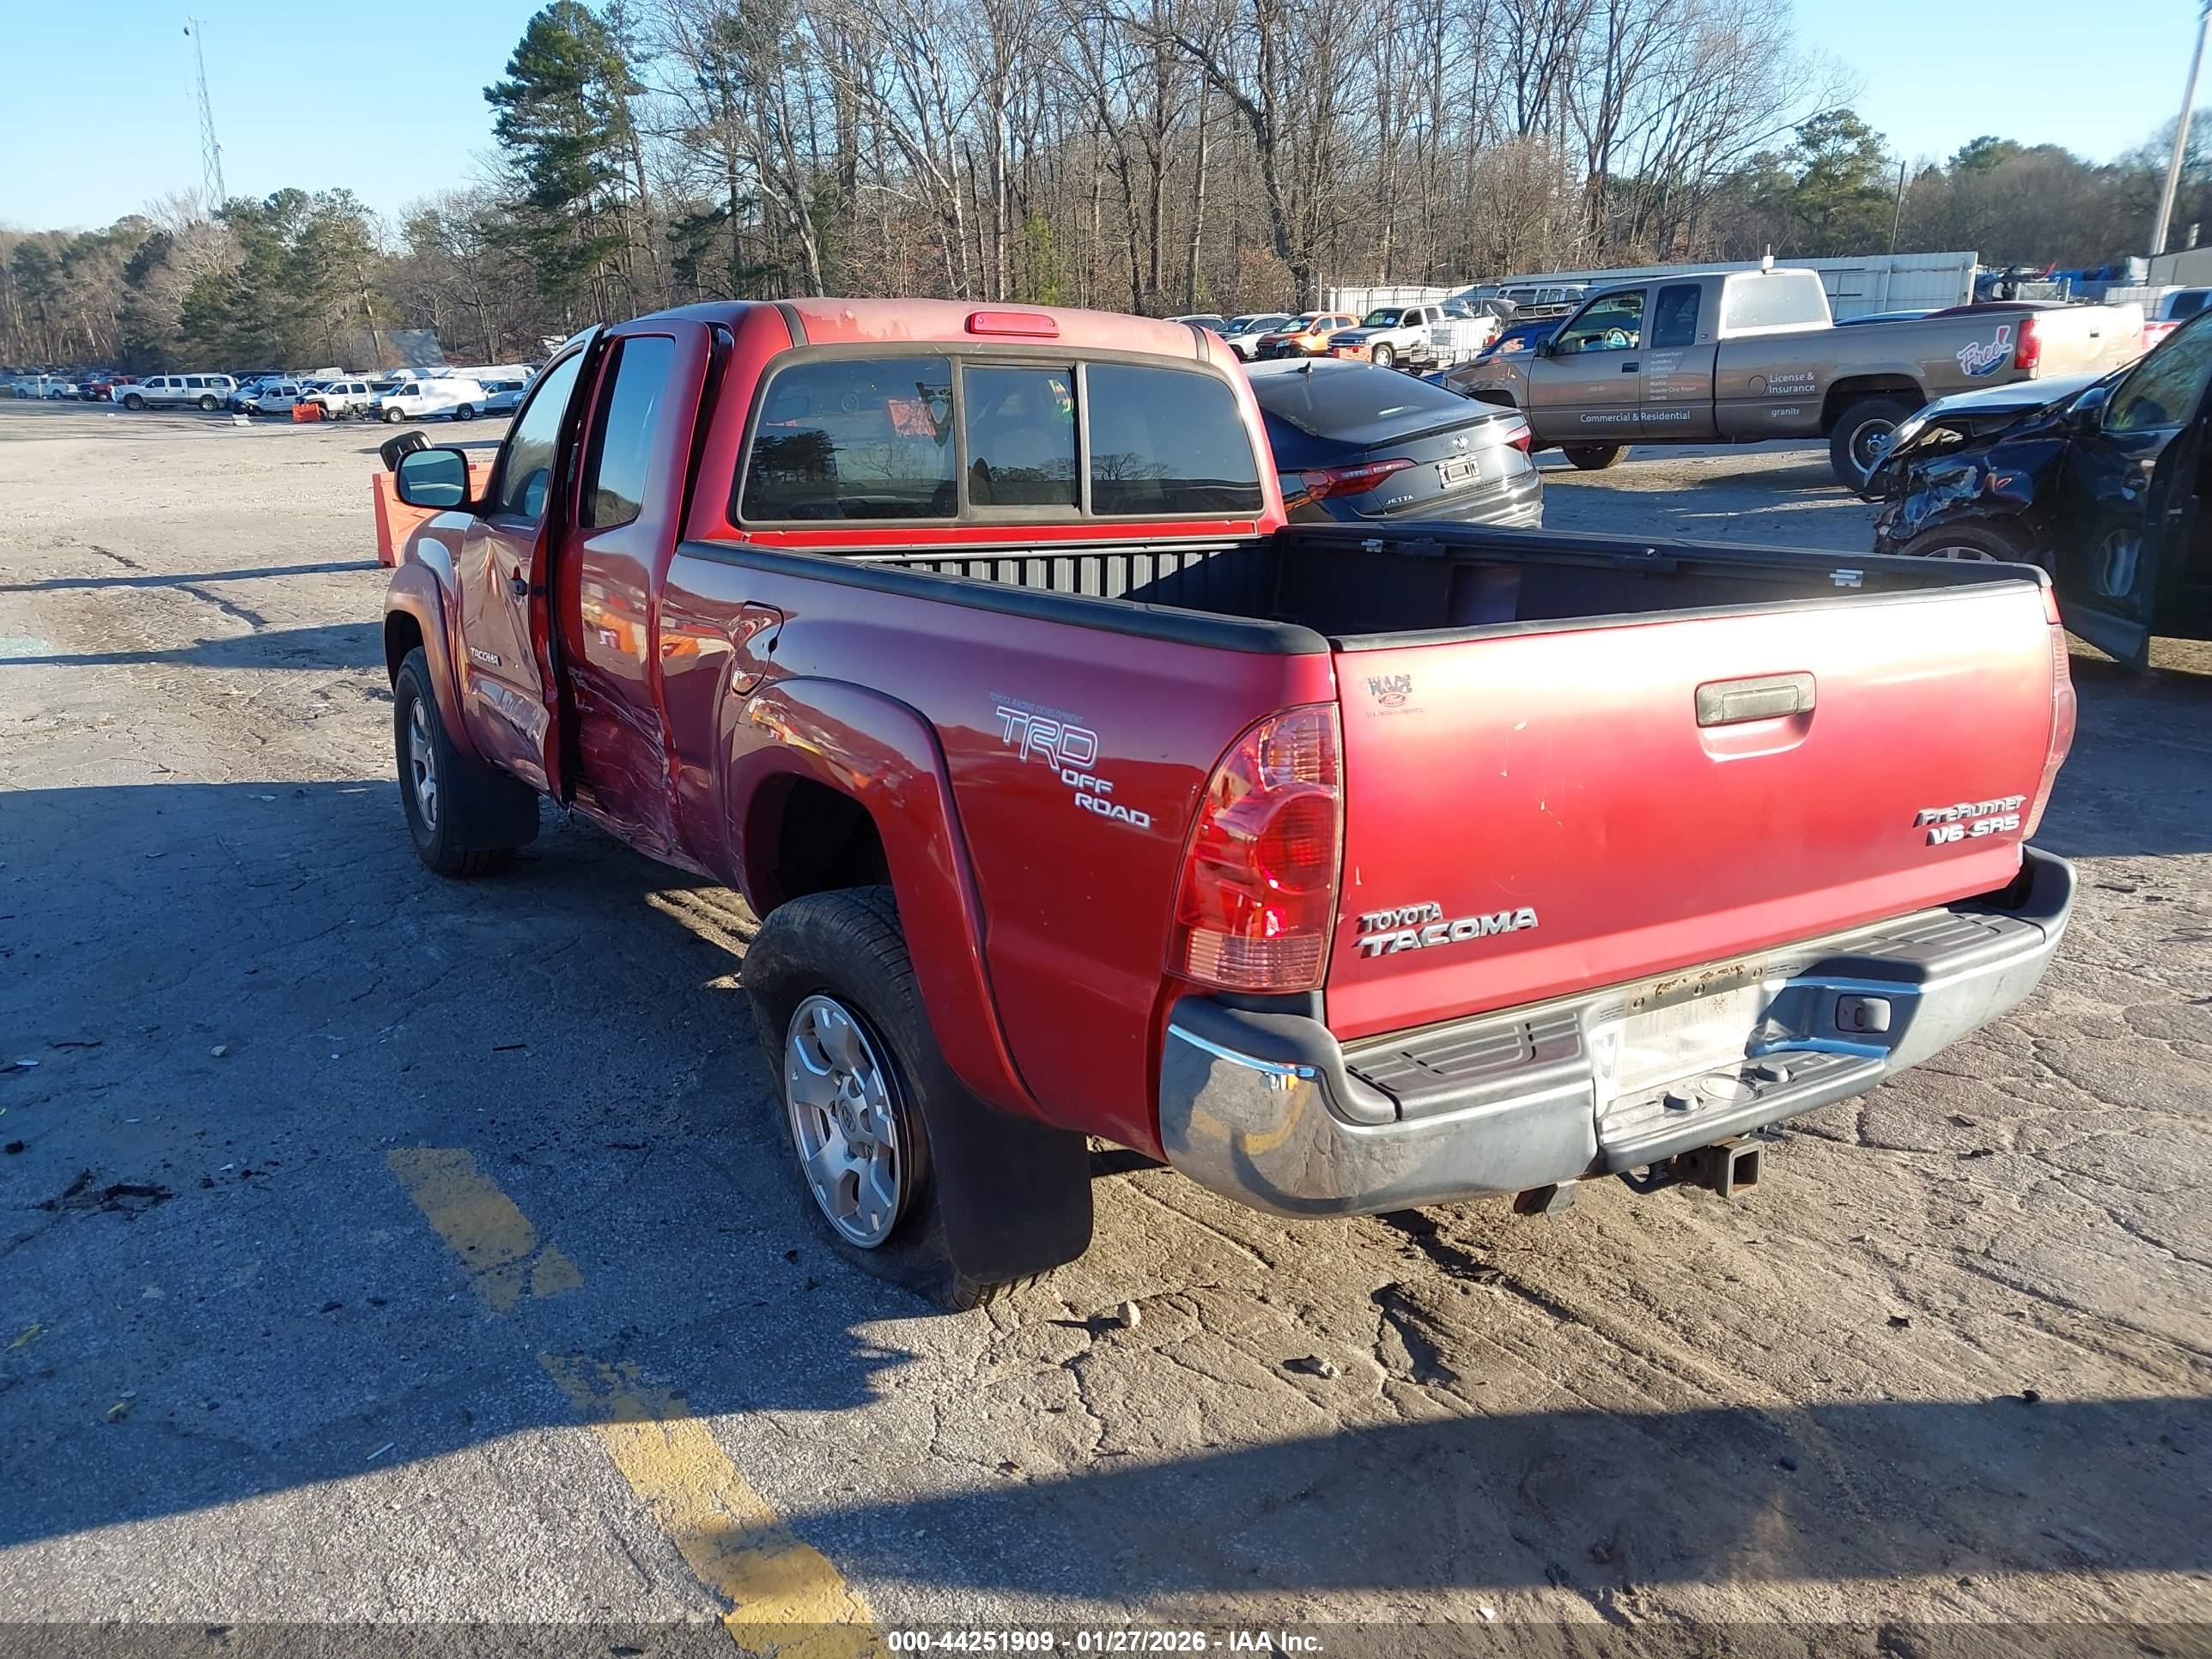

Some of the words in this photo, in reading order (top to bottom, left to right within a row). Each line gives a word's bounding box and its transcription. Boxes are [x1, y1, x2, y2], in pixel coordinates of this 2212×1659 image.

[1769, 384, 1815, 394] Insurance
[1770, 373, 1805, 383] License
[1807, 371, 1814, 380] &
[1580, 413, 1631, 422] Commercial
[1641, 410, 1691, 421] Residential
[1386, 495, 1414, 505] JETTA
[470, 647, 500, 666] TACOMA
[1012, 698, 1035, 712] RACING
[1036, 705, 1084, 724] DEVELOPMENT
[996, 706, 1098, 770] TRD
[1061, 769, 1114, 793] OFF
[1074, 792, 1151, 829] ROAD
[1915, 794, 2027, 827] PreRunner
[1928, 823, 1965, 845] V6
[1969, 814, 2021, 837] SR5
[1358, 902, 1443, 933] TOYOTA
[1358, 907, 1540, 957] TACOMA
